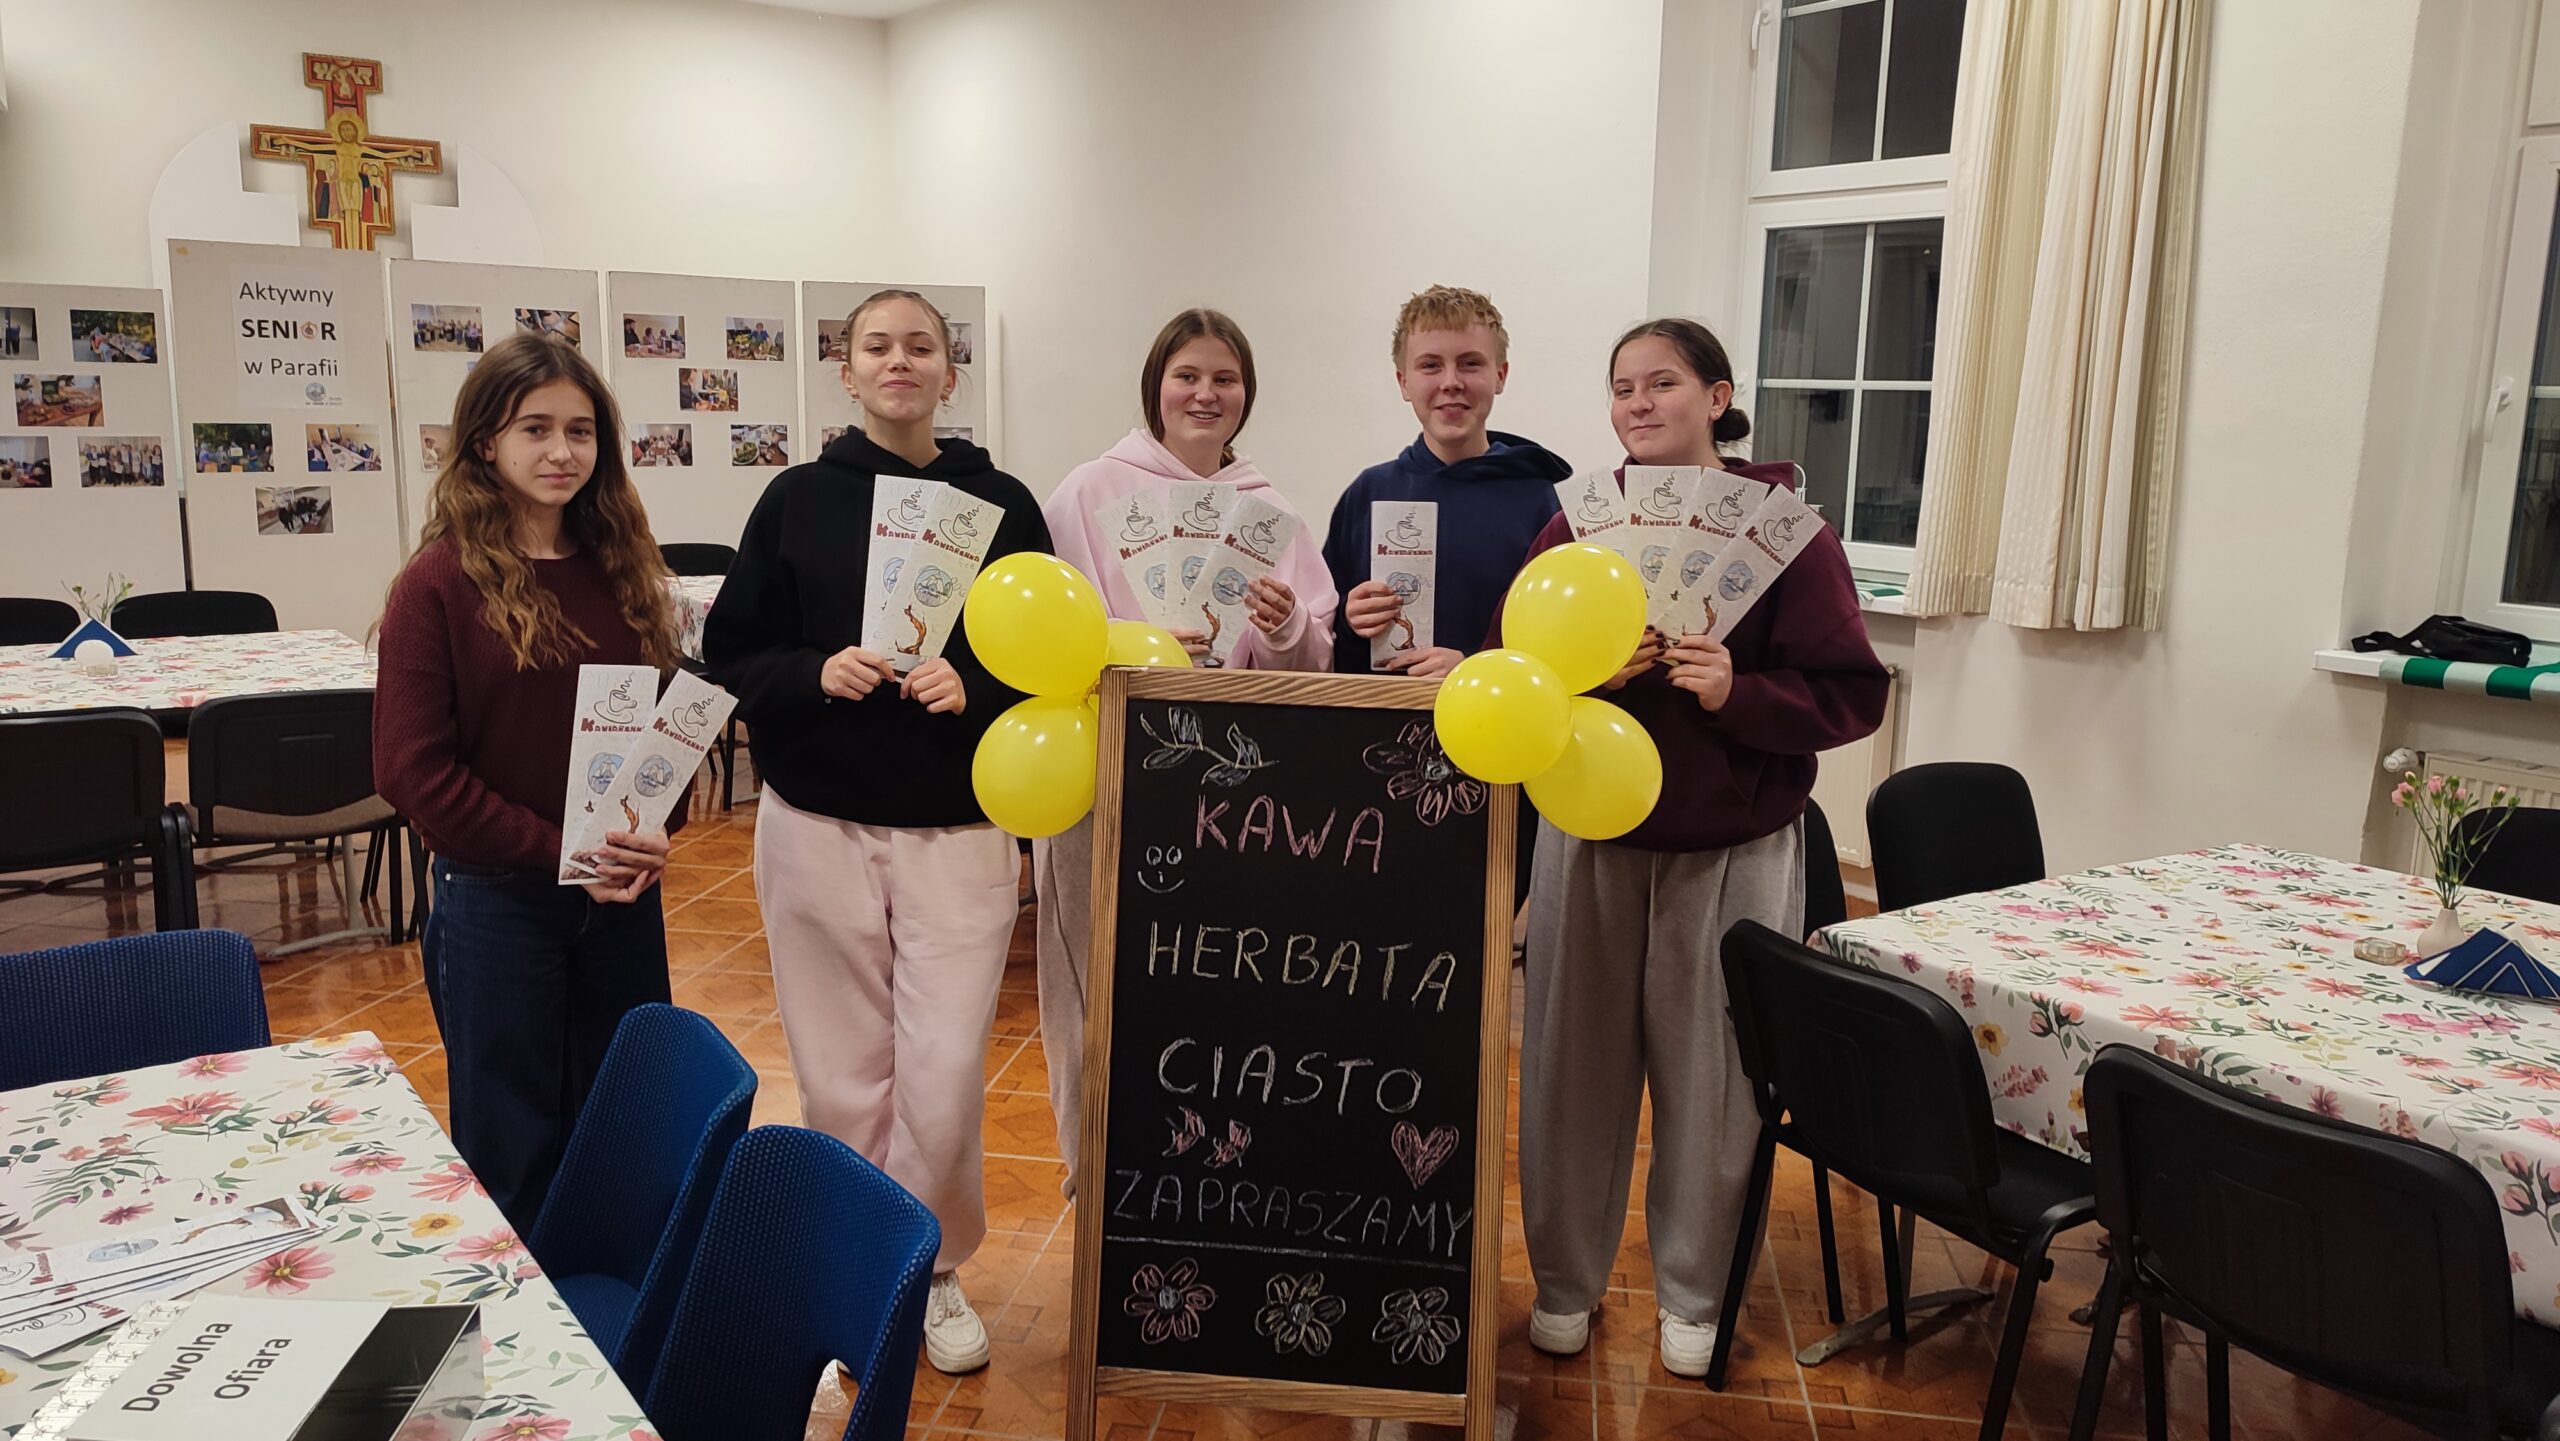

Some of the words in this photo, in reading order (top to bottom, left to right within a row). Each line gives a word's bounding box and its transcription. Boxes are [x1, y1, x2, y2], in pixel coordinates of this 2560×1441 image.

[239, 282, 334, 307] Aktywny
[241, 318, 337, 341] SENIOR
[244, 361, 263, 375] w
[271, 358, 338, 377] Parafii
[1196, 795, 1385, 874] KAWA
[1149, 921, 1457, 1013] HERBATA
[1158, 1037, 1423, 1115] CIASTO
[1112, 1169, 1474, 1258] ZAPRASZAMY
[121, 1322, 234, 1412] Dowolna
[213, 1338, 293, 1400] Ofiara
